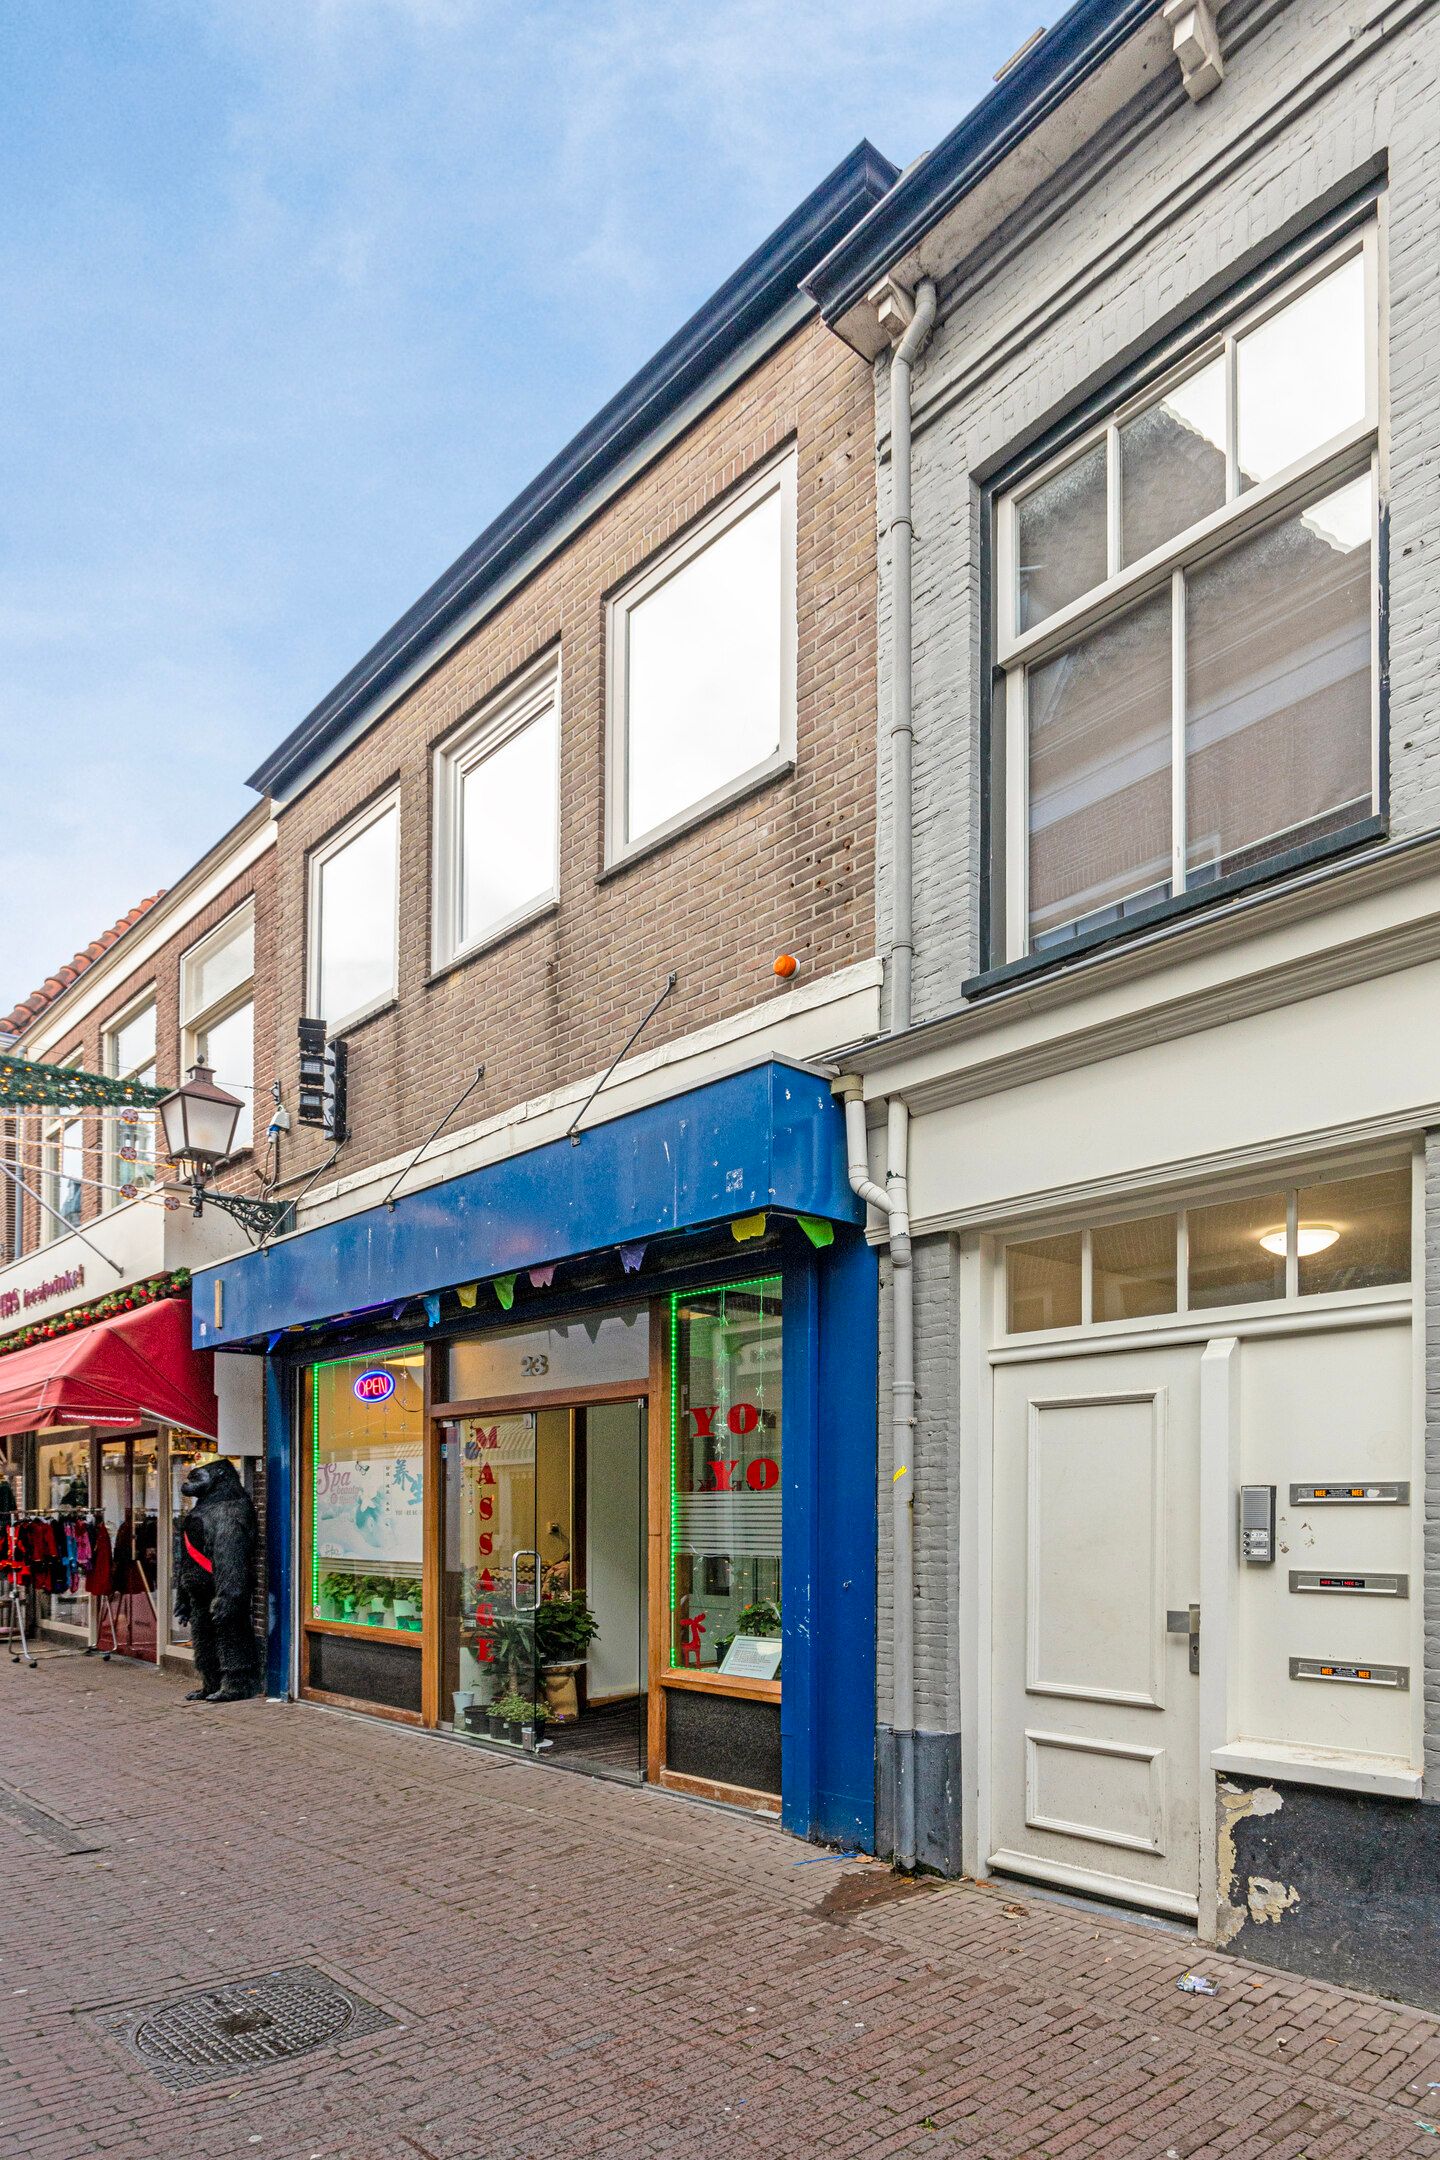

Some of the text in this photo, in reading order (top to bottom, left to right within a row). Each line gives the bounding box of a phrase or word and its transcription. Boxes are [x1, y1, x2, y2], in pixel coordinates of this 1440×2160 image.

[521, 1355, 548, 1377] 23
[357, 1376, 389, 1397] OPEN
[690, 1403, 759, 1437] YO
[317, 1463, 352, 1495] Spa
[706, 1457, 780, 1491] YO
[474, 1425, 501, 1663] MASSAGE
